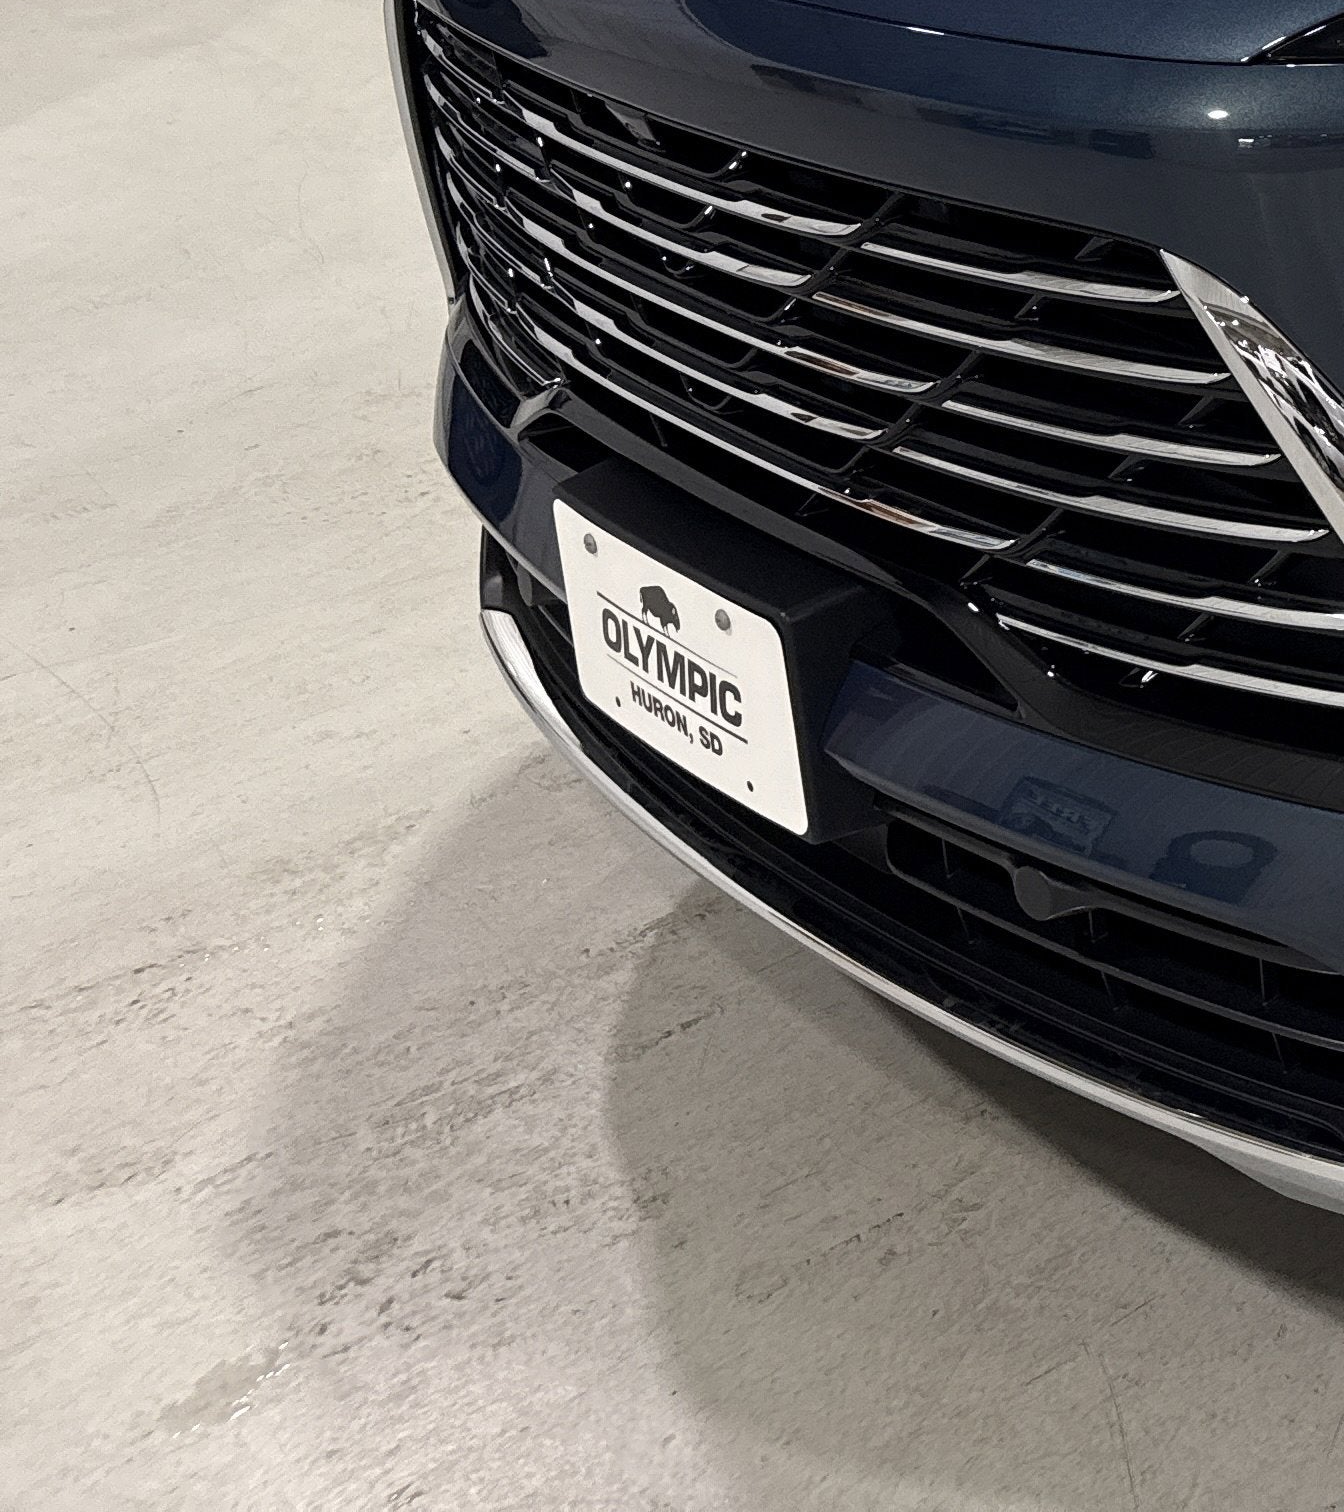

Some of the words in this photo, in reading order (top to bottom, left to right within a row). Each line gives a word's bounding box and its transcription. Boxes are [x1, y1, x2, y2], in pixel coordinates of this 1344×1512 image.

[602, 608, 742, 727] OLYMPIC
[630, 680, 694, 744] HURON,
[699, 724, 723, 757] SD
